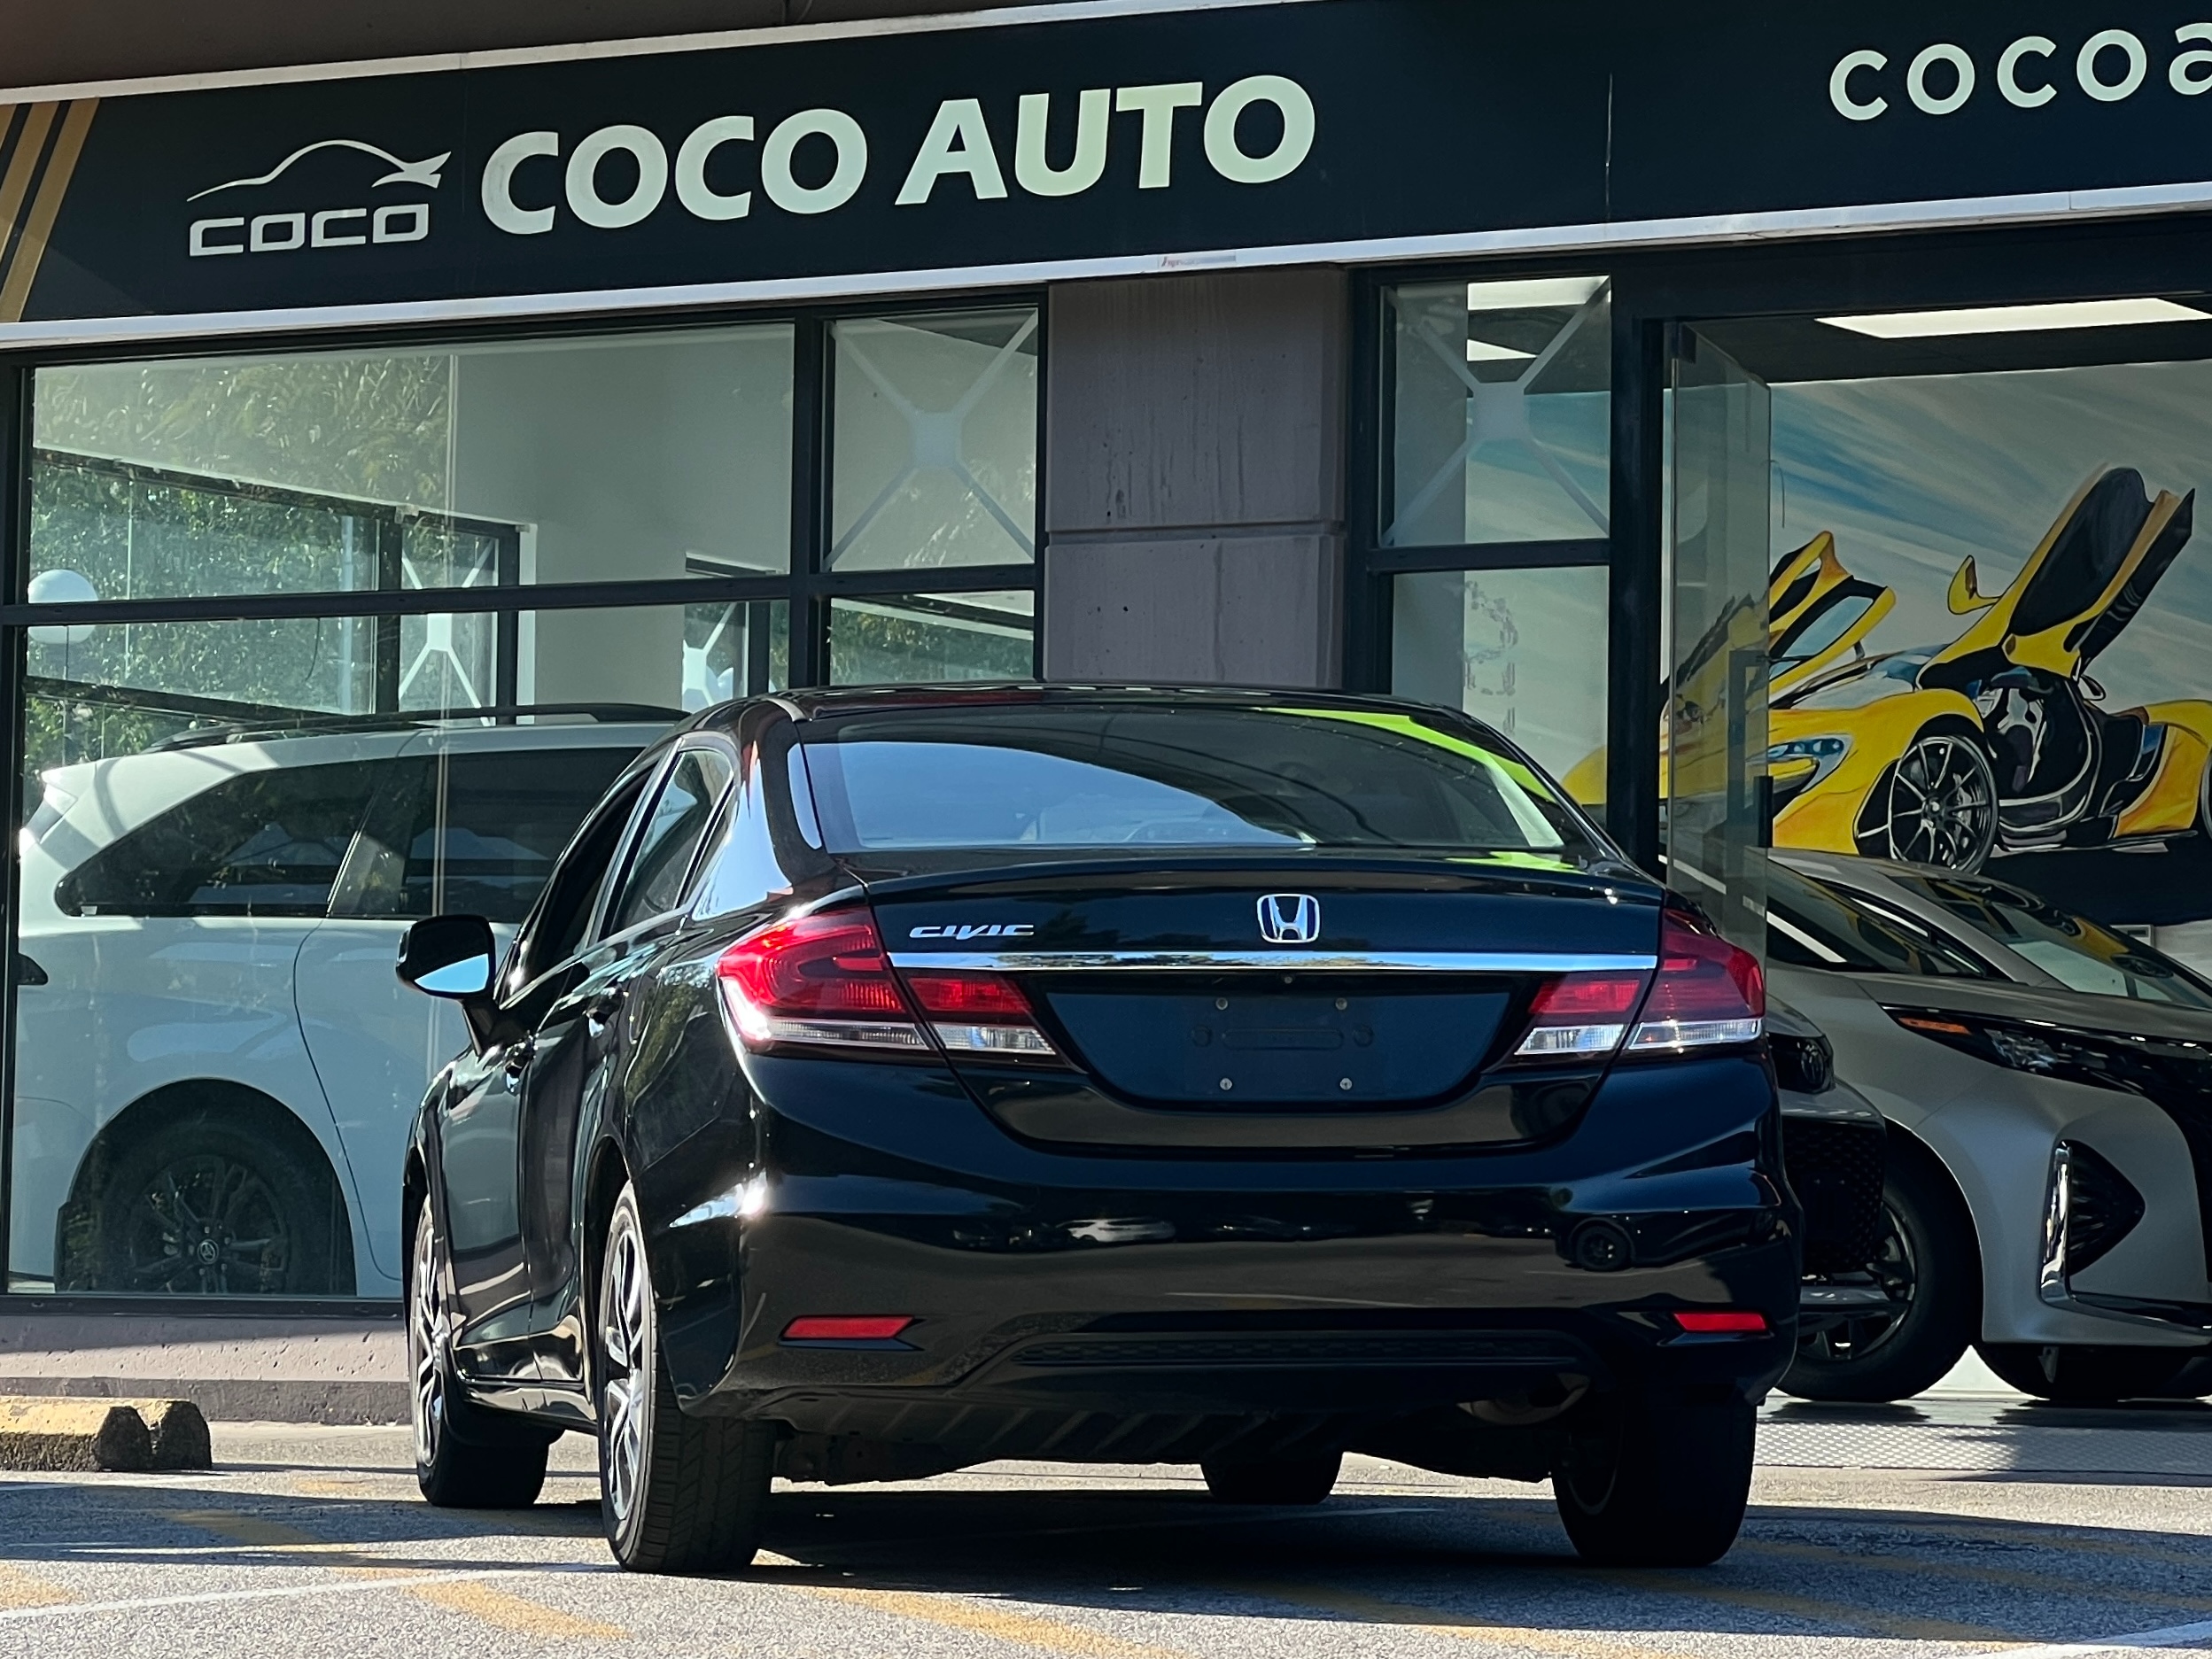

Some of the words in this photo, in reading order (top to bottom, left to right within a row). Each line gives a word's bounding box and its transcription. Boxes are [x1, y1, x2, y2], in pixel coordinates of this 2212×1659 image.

[481, 108, 868, 235] COCO
[894, 74, 1316, 205] AUTO
[189, 203, 429, 257] COCO
[909, 924, 1035, 941] CIVIC
